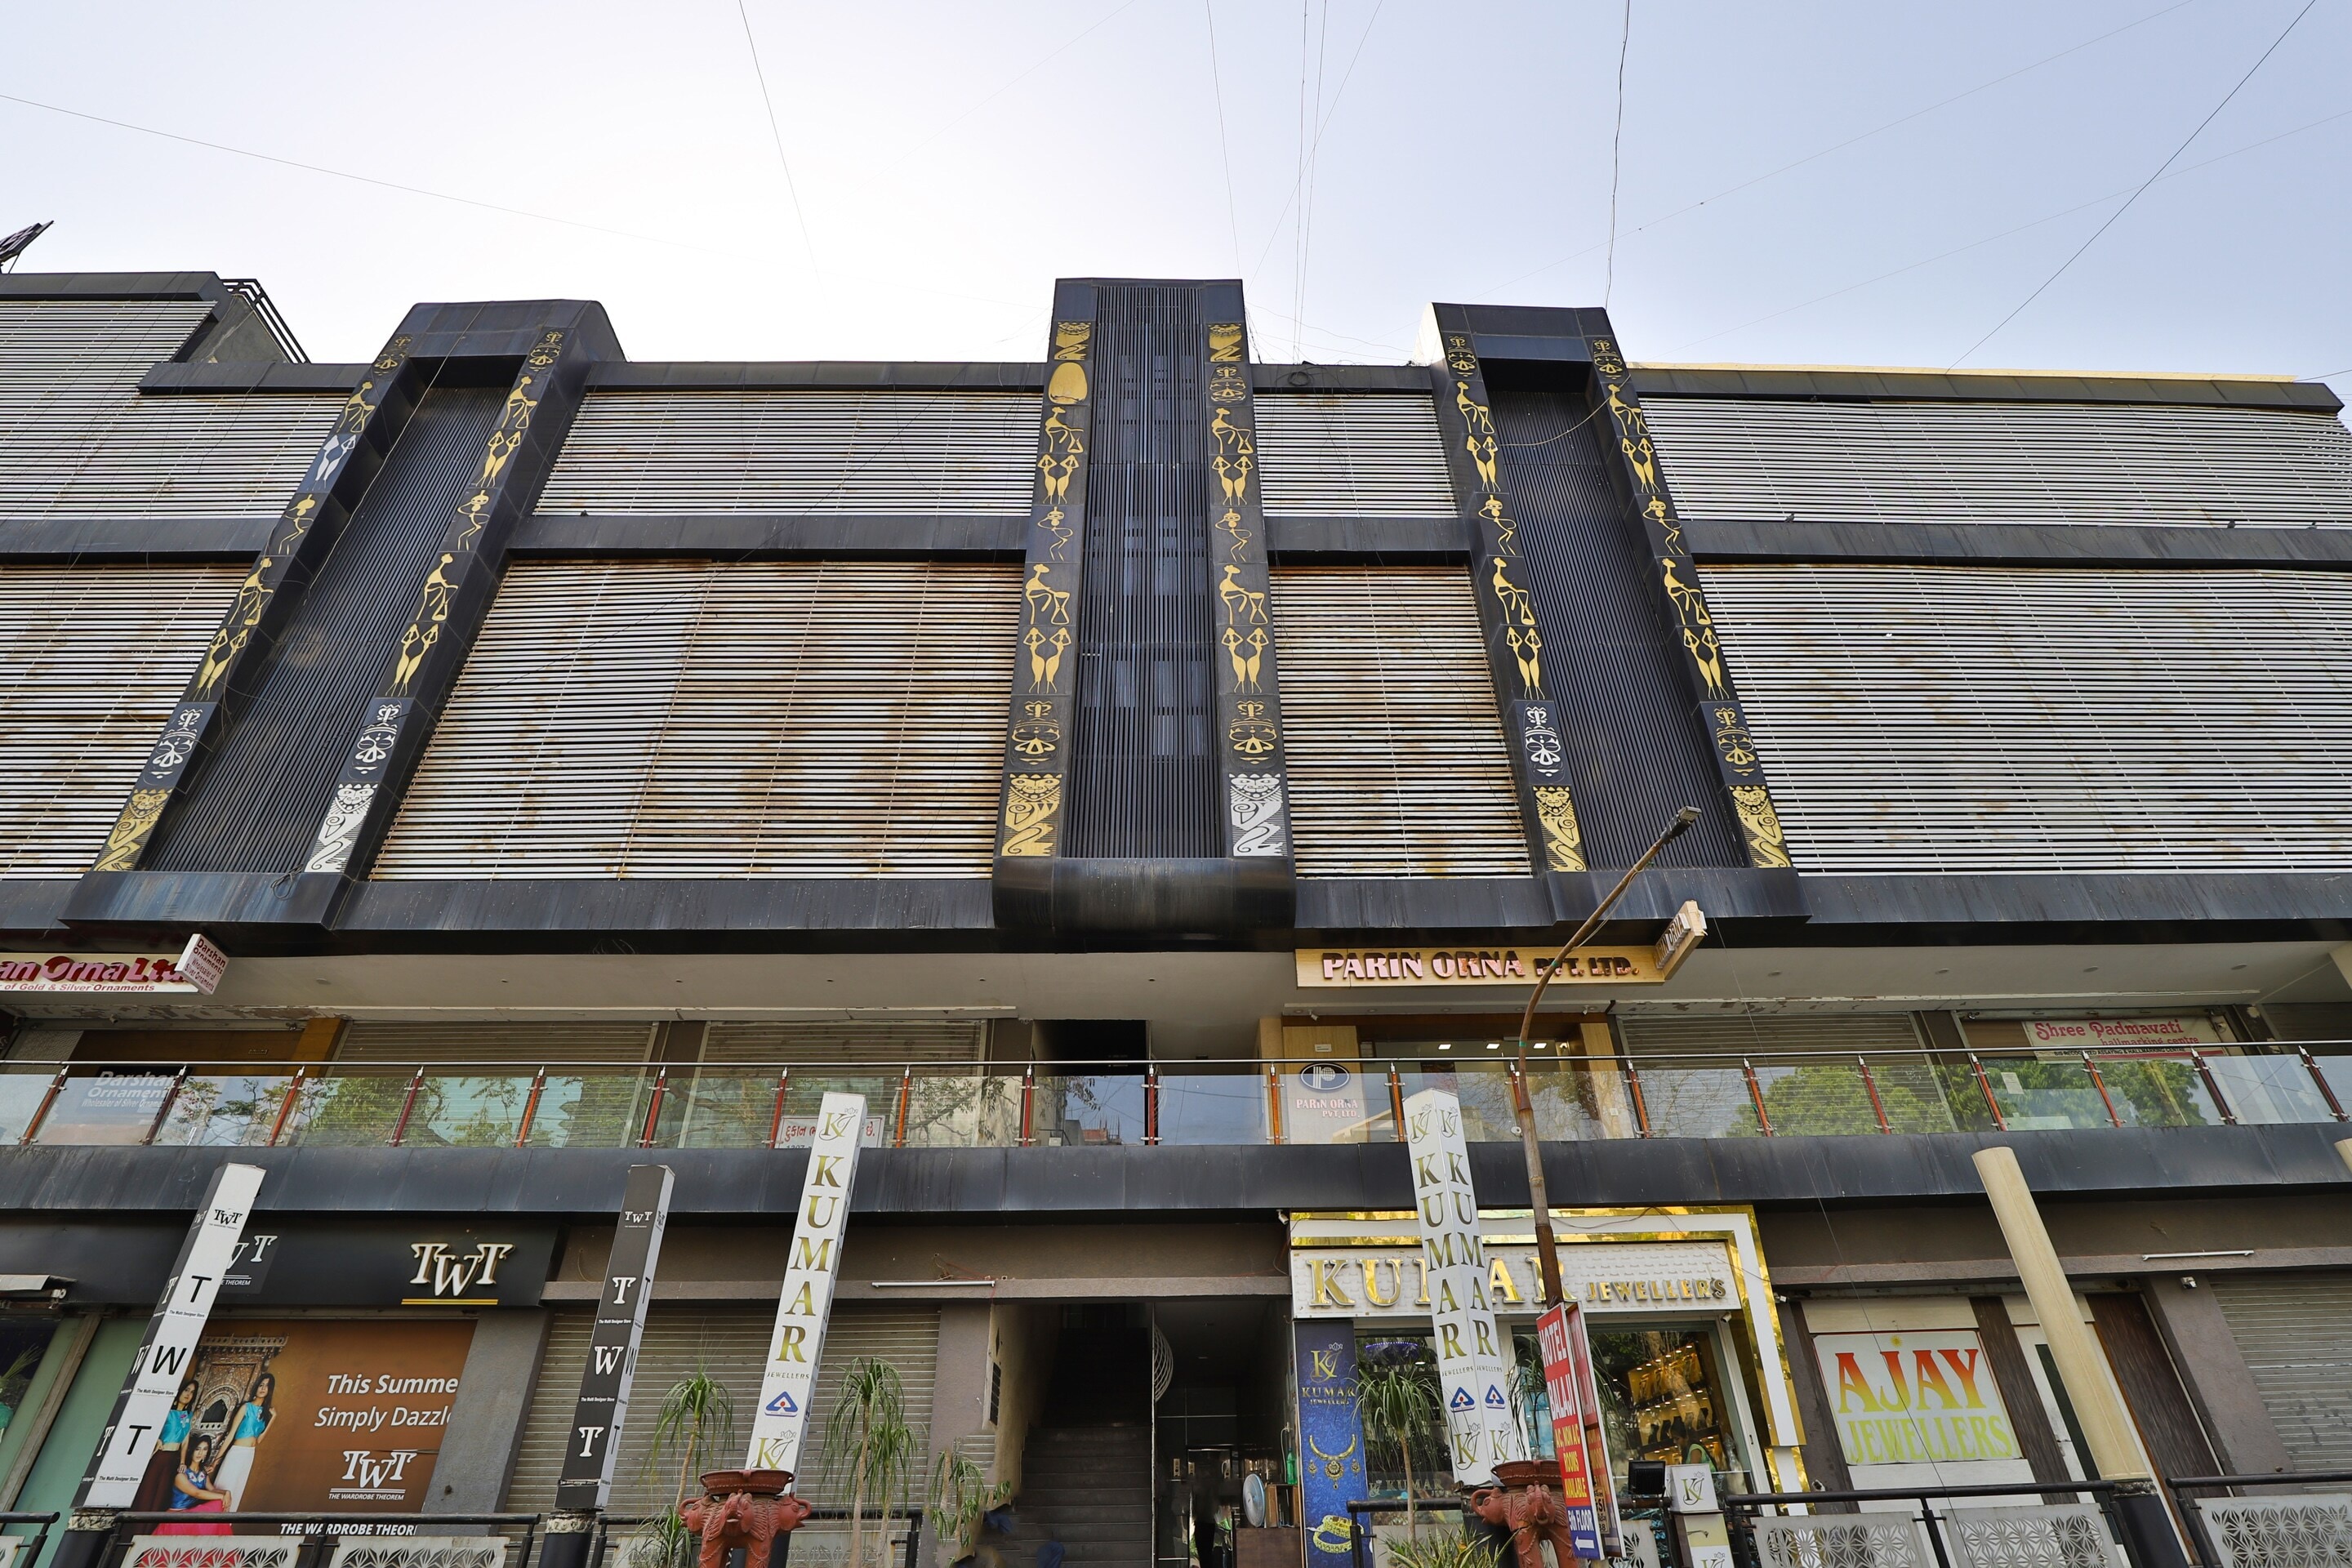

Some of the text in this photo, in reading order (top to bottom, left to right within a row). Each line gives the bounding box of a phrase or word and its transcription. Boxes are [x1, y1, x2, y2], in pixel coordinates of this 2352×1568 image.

[193, 947, 223, 974] Ornaments
[197, 938, 226, 968] Darshan
[1321, 951, 1423, 979] PARIN
[1431, 950, 1526, 978] ORNA
[60, 983, 91, 991] Silver
[2034, 1019, 2185, 1041] Shree Padmavati
[2167, 1036, 2199, 1045] centre
[214, 1209, 243, 1225] TWT
[625, 1211, 653, 1223] TWT
[775, 1155, 844, 1363] KUMAR
[1415, 1152, 1468, 1361] KUMAR
[1446, 1151, 1497, 1356] KUMAR
[409, 1243, 515, 1297] TWT
[1586, 1278, 1726, 1302] JEWELLERS
[1539, 1319, 1568, 1368] HOTEL
[327, 1374, 372, 1394] This
[1442, 1365, 1473, 1377] JEWELLERS
[1835, 1349, 1987, 1414] AJAY
[1301, 1387, 1356, 1398] KUMAR
[1547, 1374, 1576, 1421] BALAJI
[314, 1405, 452, 1432] Simply Dazzl
[1847, 1415, 2013, 1464] JEWELLERS
[341, 1450, 417, 1488] TWT
[280, 1523, 303, 1535] THE
[375, 1524, 418, 1535] THEOR
